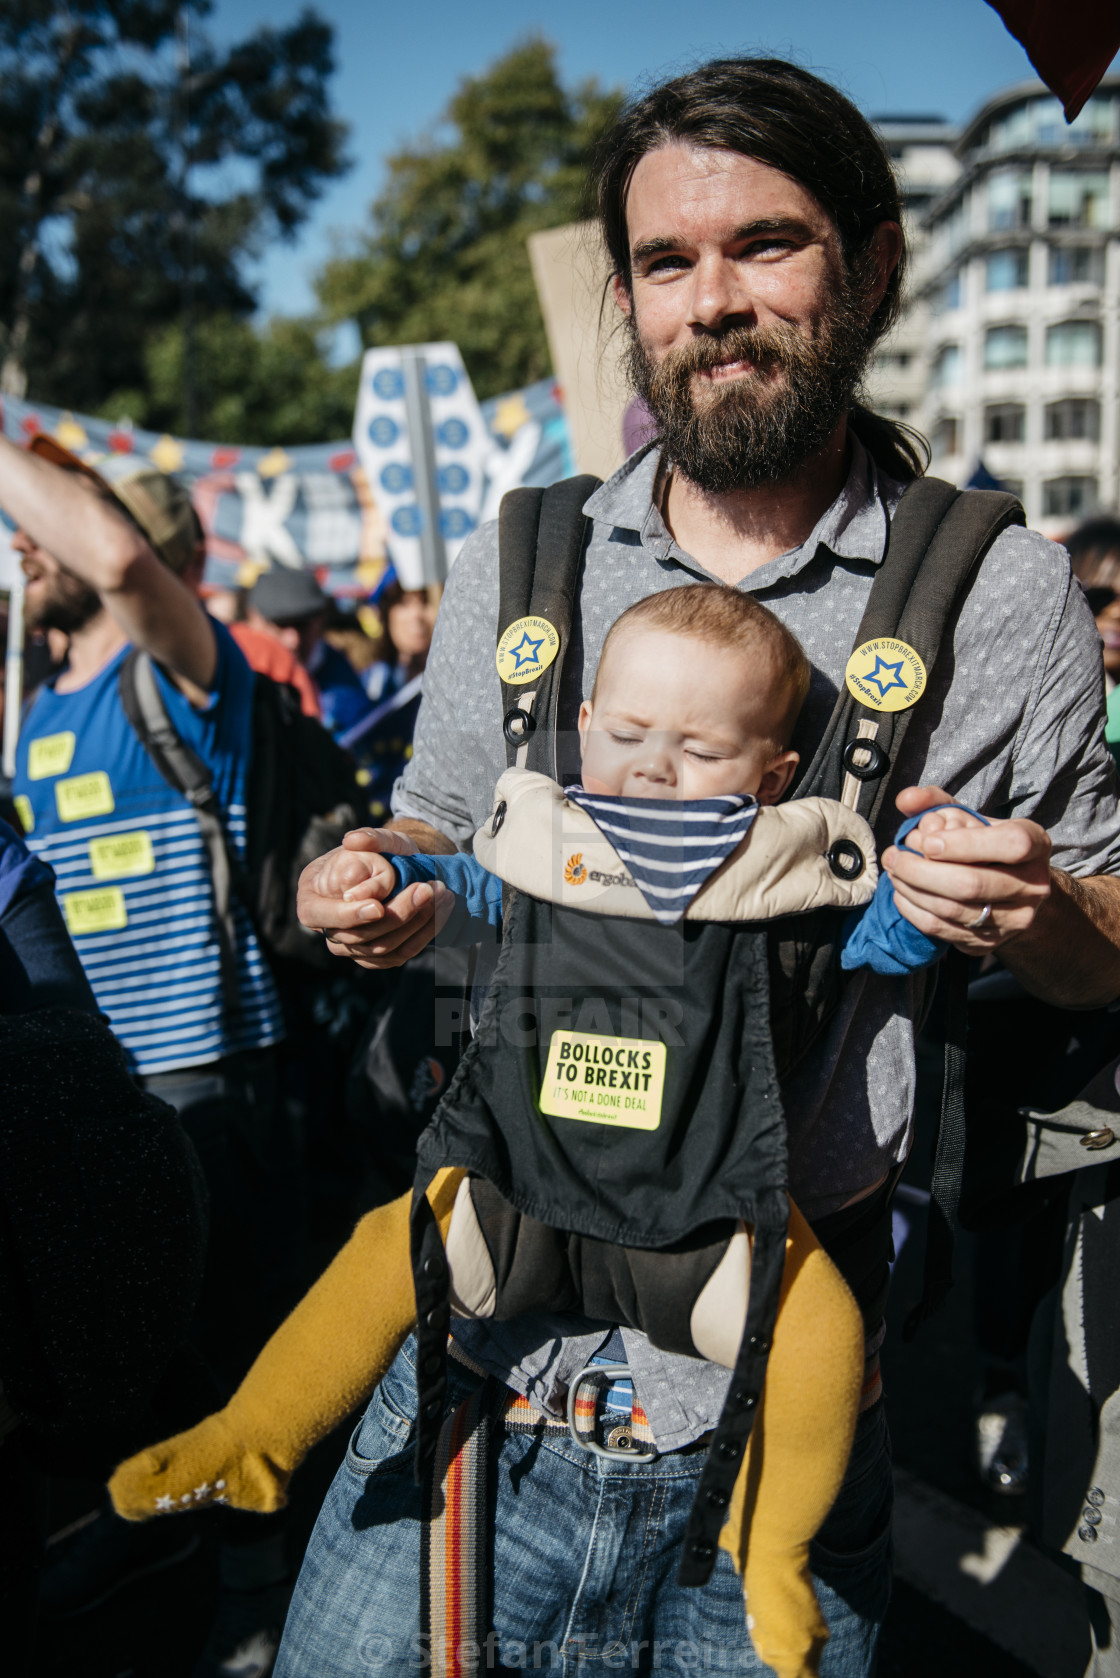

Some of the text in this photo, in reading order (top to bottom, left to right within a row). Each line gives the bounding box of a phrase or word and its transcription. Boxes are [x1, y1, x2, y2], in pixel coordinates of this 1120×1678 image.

[508, 664, 543, 680] #StopBrexit
[860, 641, 923, 702] WWW.STOPBREXITMARCH.COM
[849, 674, 882, 706] #StopBrexit
[589, 870, 637, 887] ergoba
[560, 1042, 652, 1070] BOLLOCKS
[556, 1062, 652, 1092] TO BREXIT
[571, 1089, 587, 1103] NOT
[589, 1092, 595, 1104] A
[597, 1093, 621, 1109] DONE
[624, 1097, 647, 1112] DEAL
